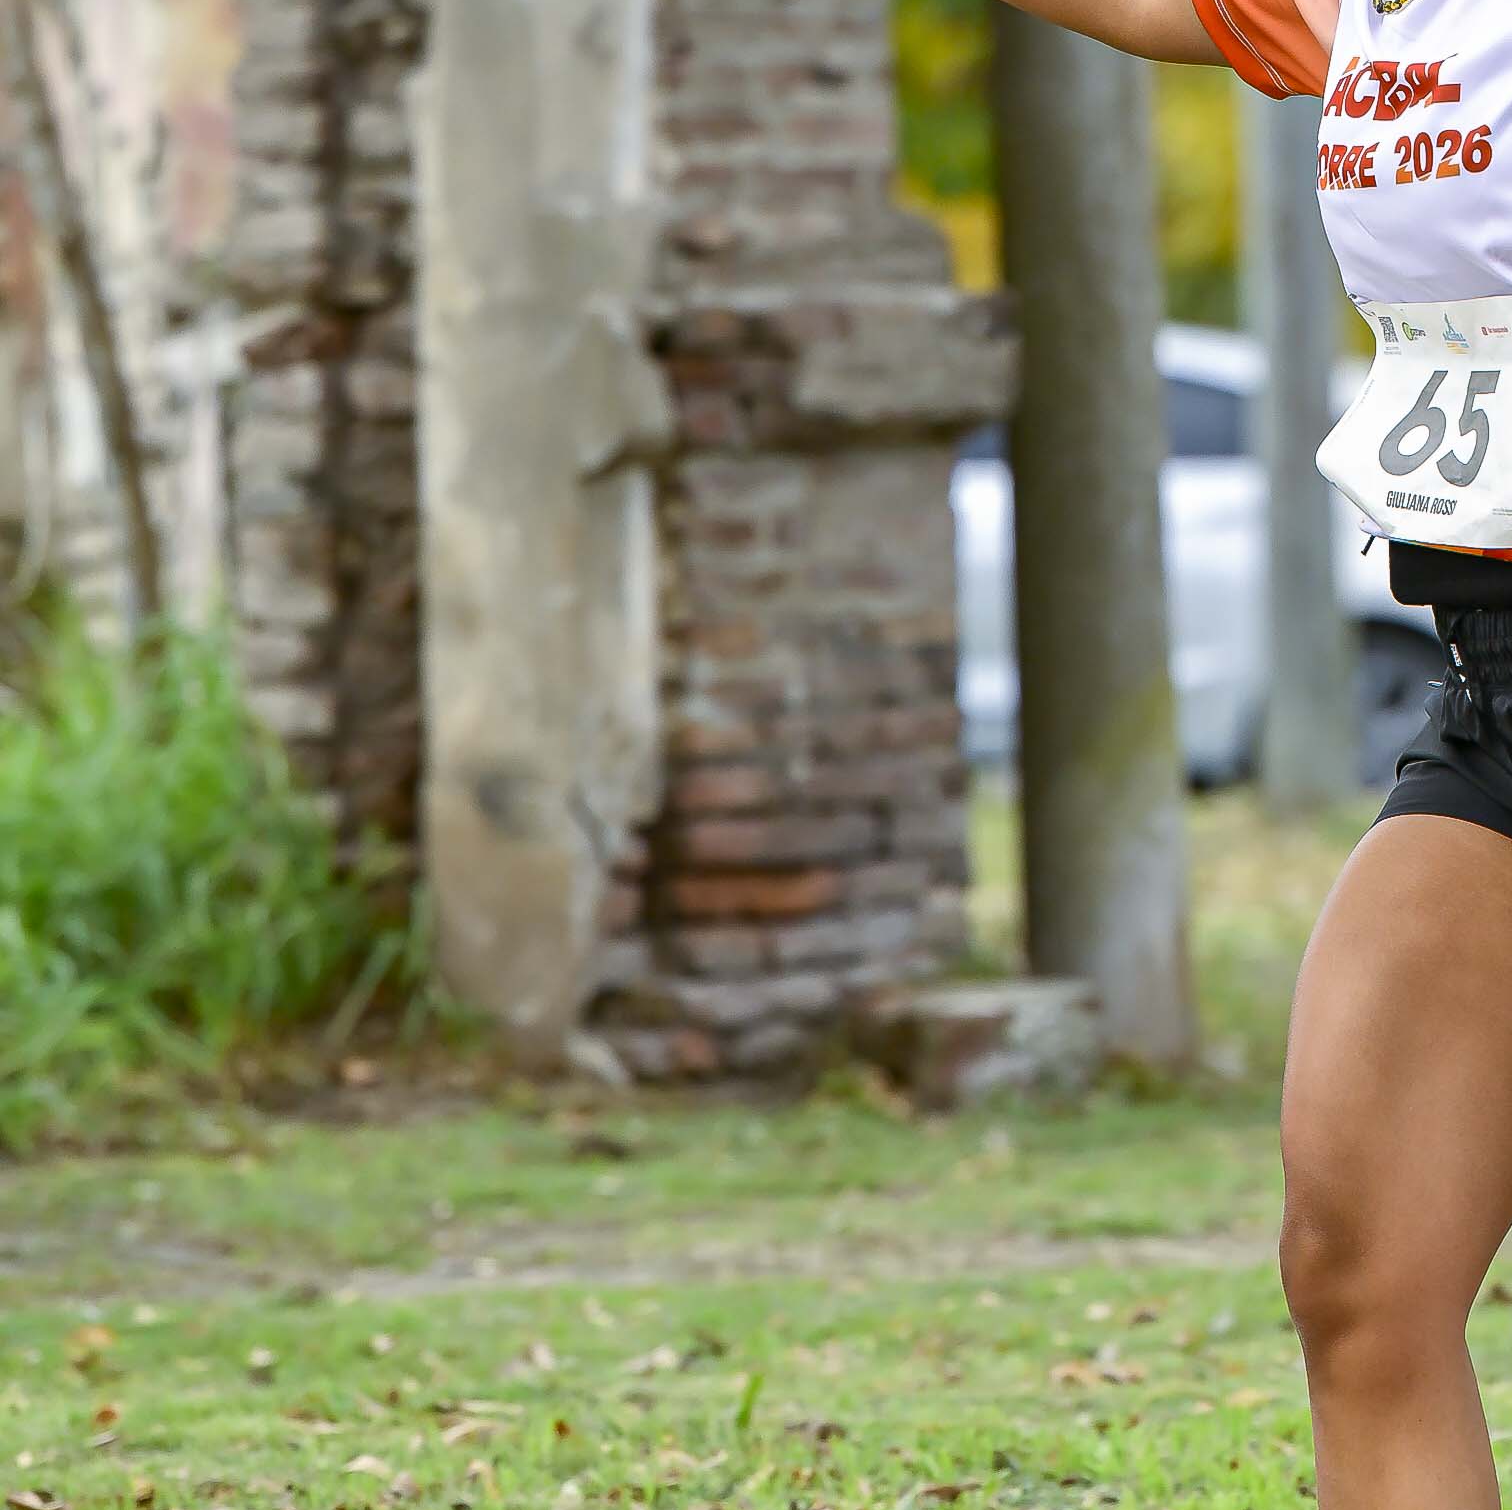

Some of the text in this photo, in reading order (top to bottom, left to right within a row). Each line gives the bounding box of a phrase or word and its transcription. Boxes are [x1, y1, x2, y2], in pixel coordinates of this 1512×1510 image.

[1317, 124, 1493, 190] ORRE 2026
[1379, 370, 1501, 487] 65
[1386, 490, 1430, 513] GIULIANA
